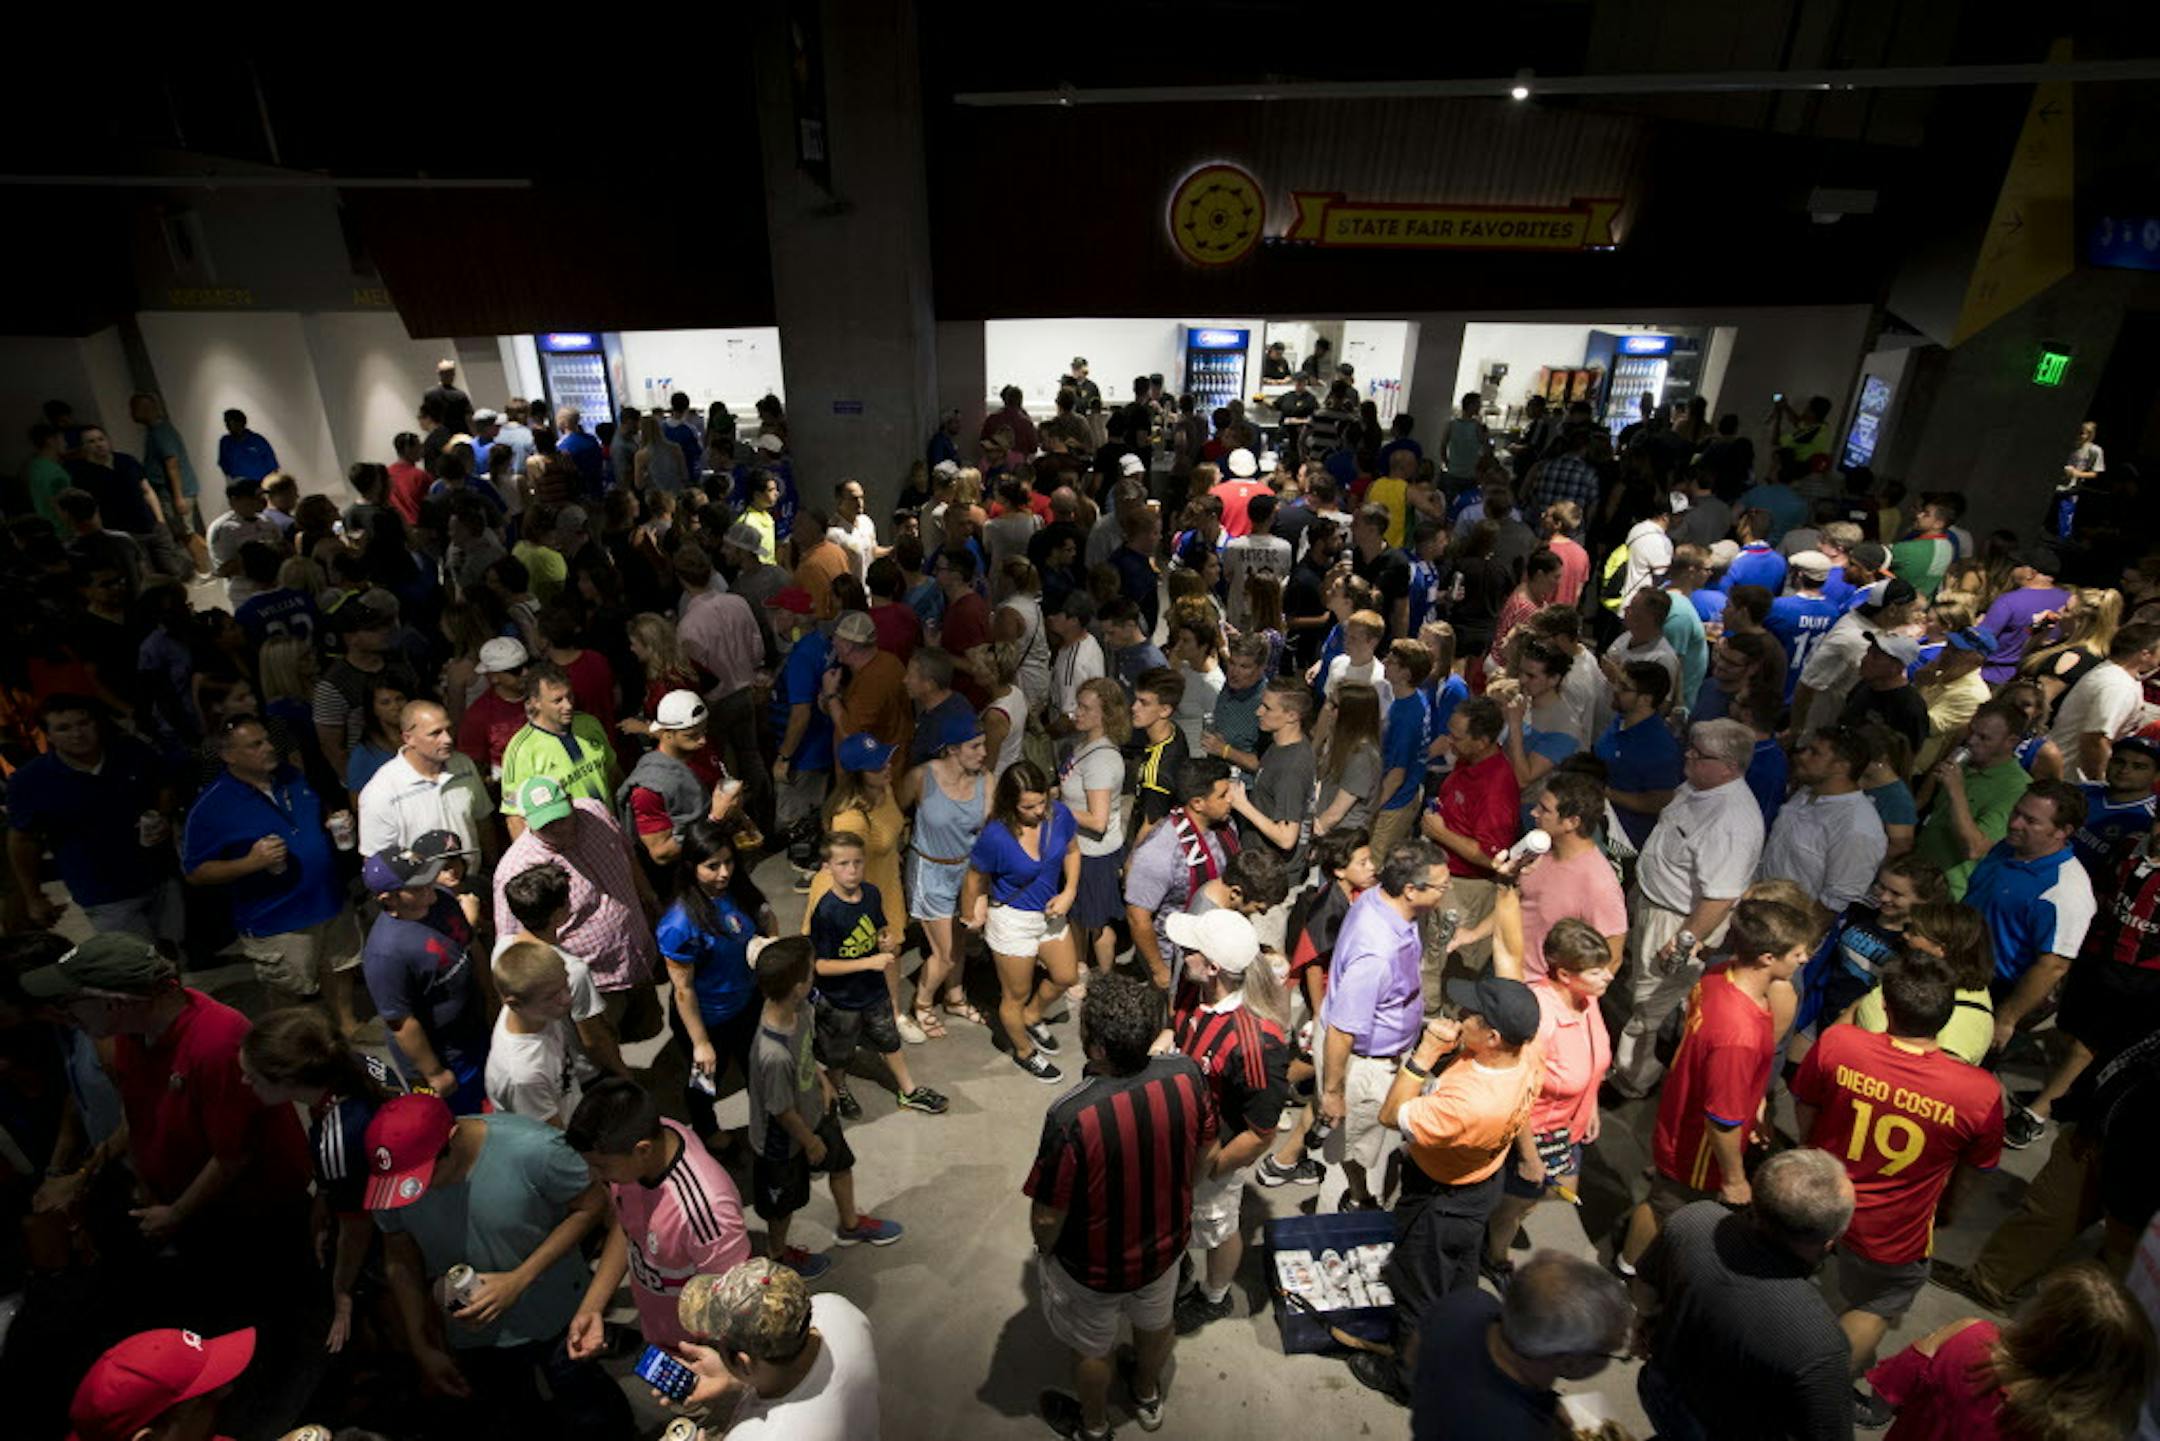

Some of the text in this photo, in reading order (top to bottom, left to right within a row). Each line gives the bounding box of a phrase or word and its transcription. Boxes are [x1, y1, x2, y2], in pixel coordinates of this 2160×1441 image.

[1338, 217, 1574, 239] STATE FAIR FAVORITES
[168, 287, 254, 304] WOMEN
[2034, 352, 2069, 384] EXIT
[1836, 1064, 1956, 1128] DIEGO COSTA
[1846, 1098, 1926, 1177] 19
